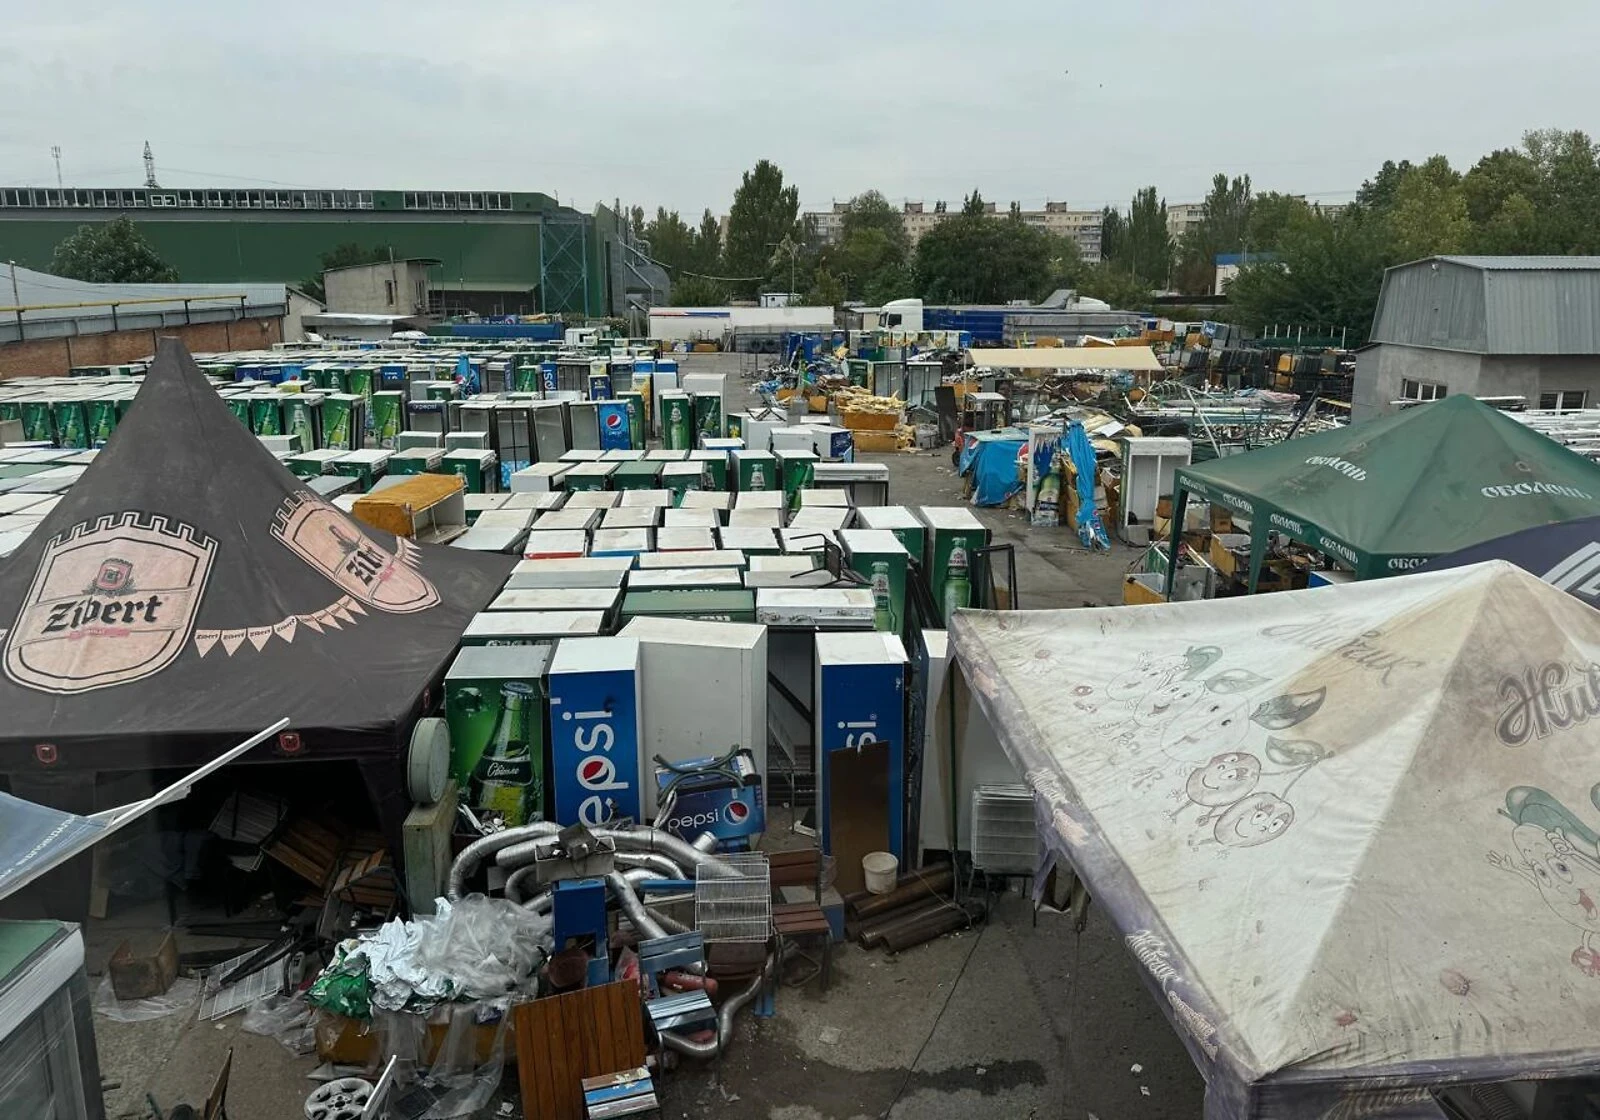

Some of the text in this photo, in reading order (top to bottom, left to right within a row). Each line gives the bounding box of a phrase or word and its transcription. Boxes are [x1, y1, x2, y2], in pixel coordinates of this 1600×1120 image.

[41, 594, 163, 635] Zibert
[1495, 660, 1600, 747] Жи
[668, 809, 719, 833] pepsi
